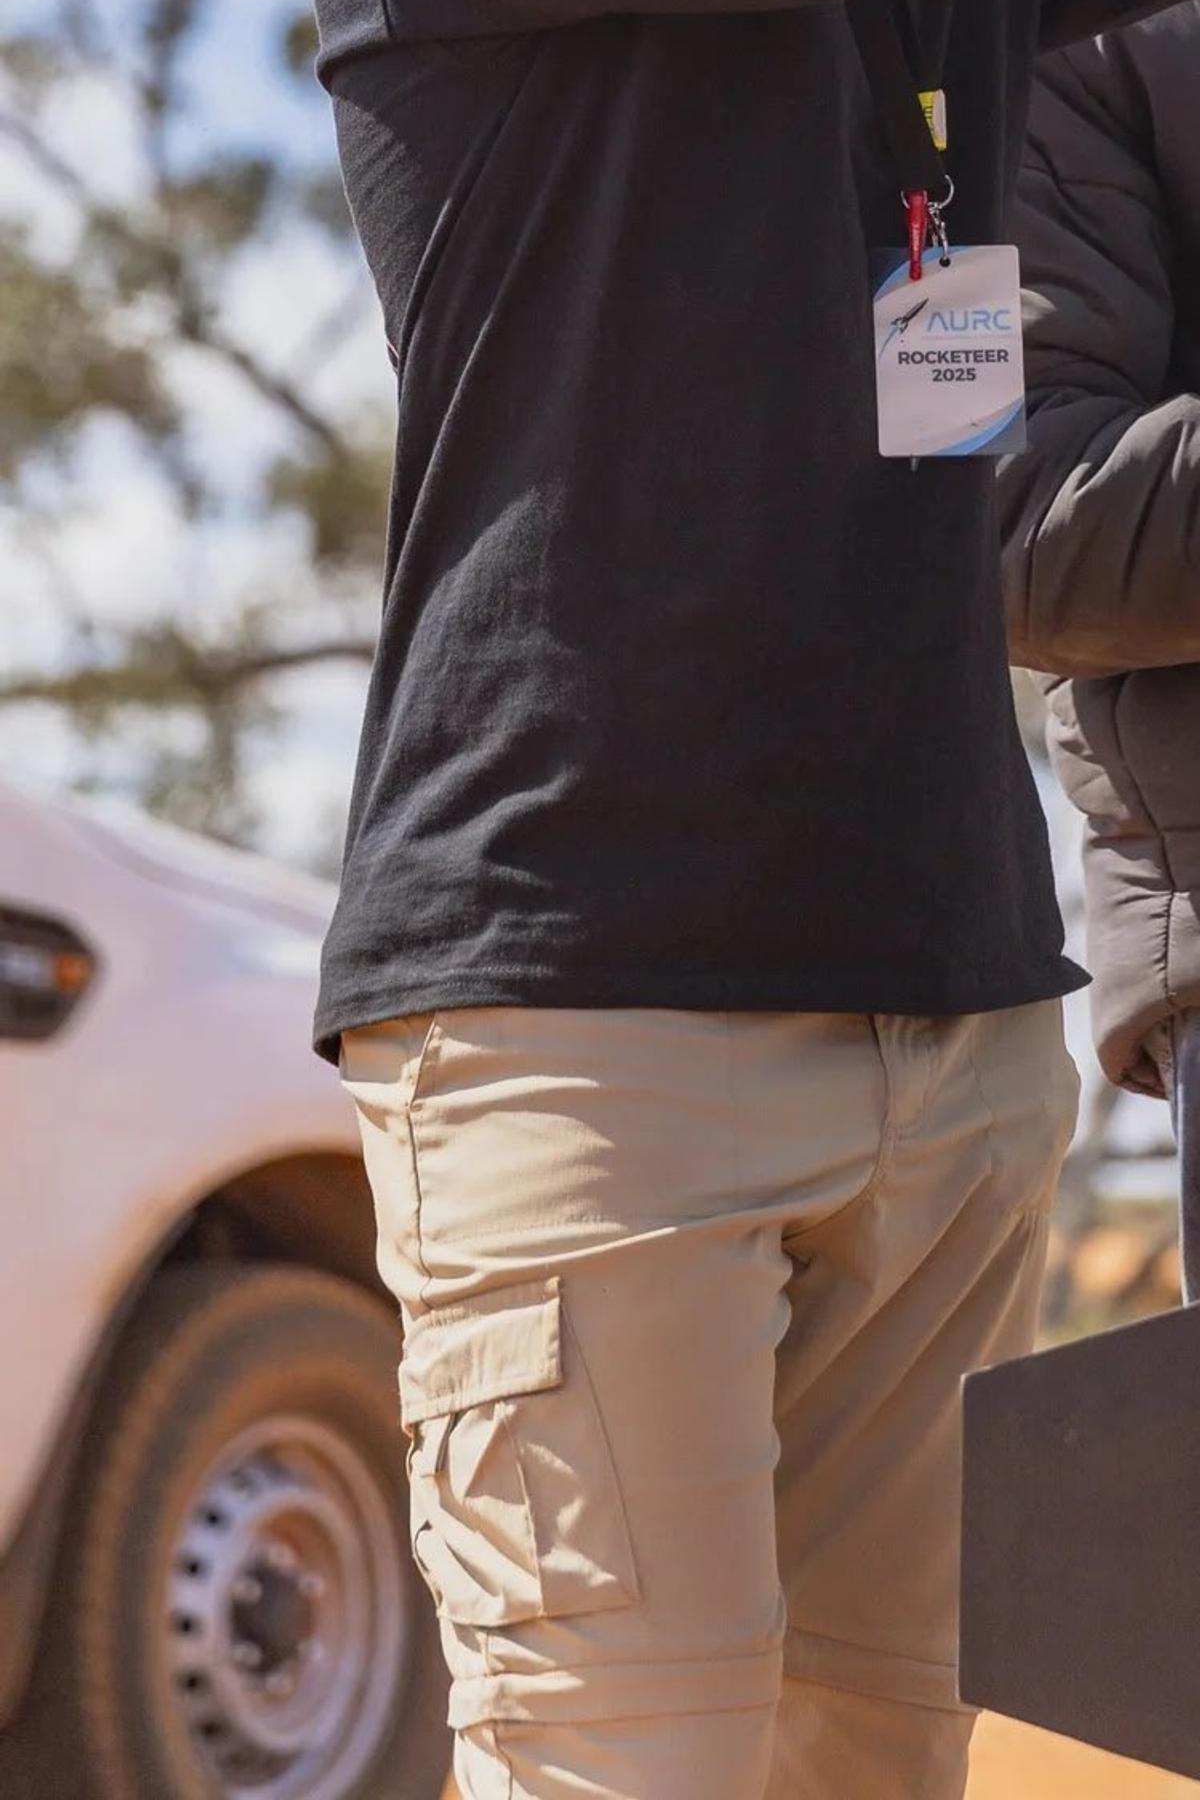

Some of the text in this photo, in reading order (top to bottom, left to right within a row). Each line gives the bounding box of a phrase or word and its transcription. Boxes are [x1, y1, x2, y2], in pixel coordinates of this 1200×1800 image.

[927, 309, 1011, 332] AURC
[897, 348, 1009, 365] ROCKETEER
[931, 367, 976, 382] 2025
